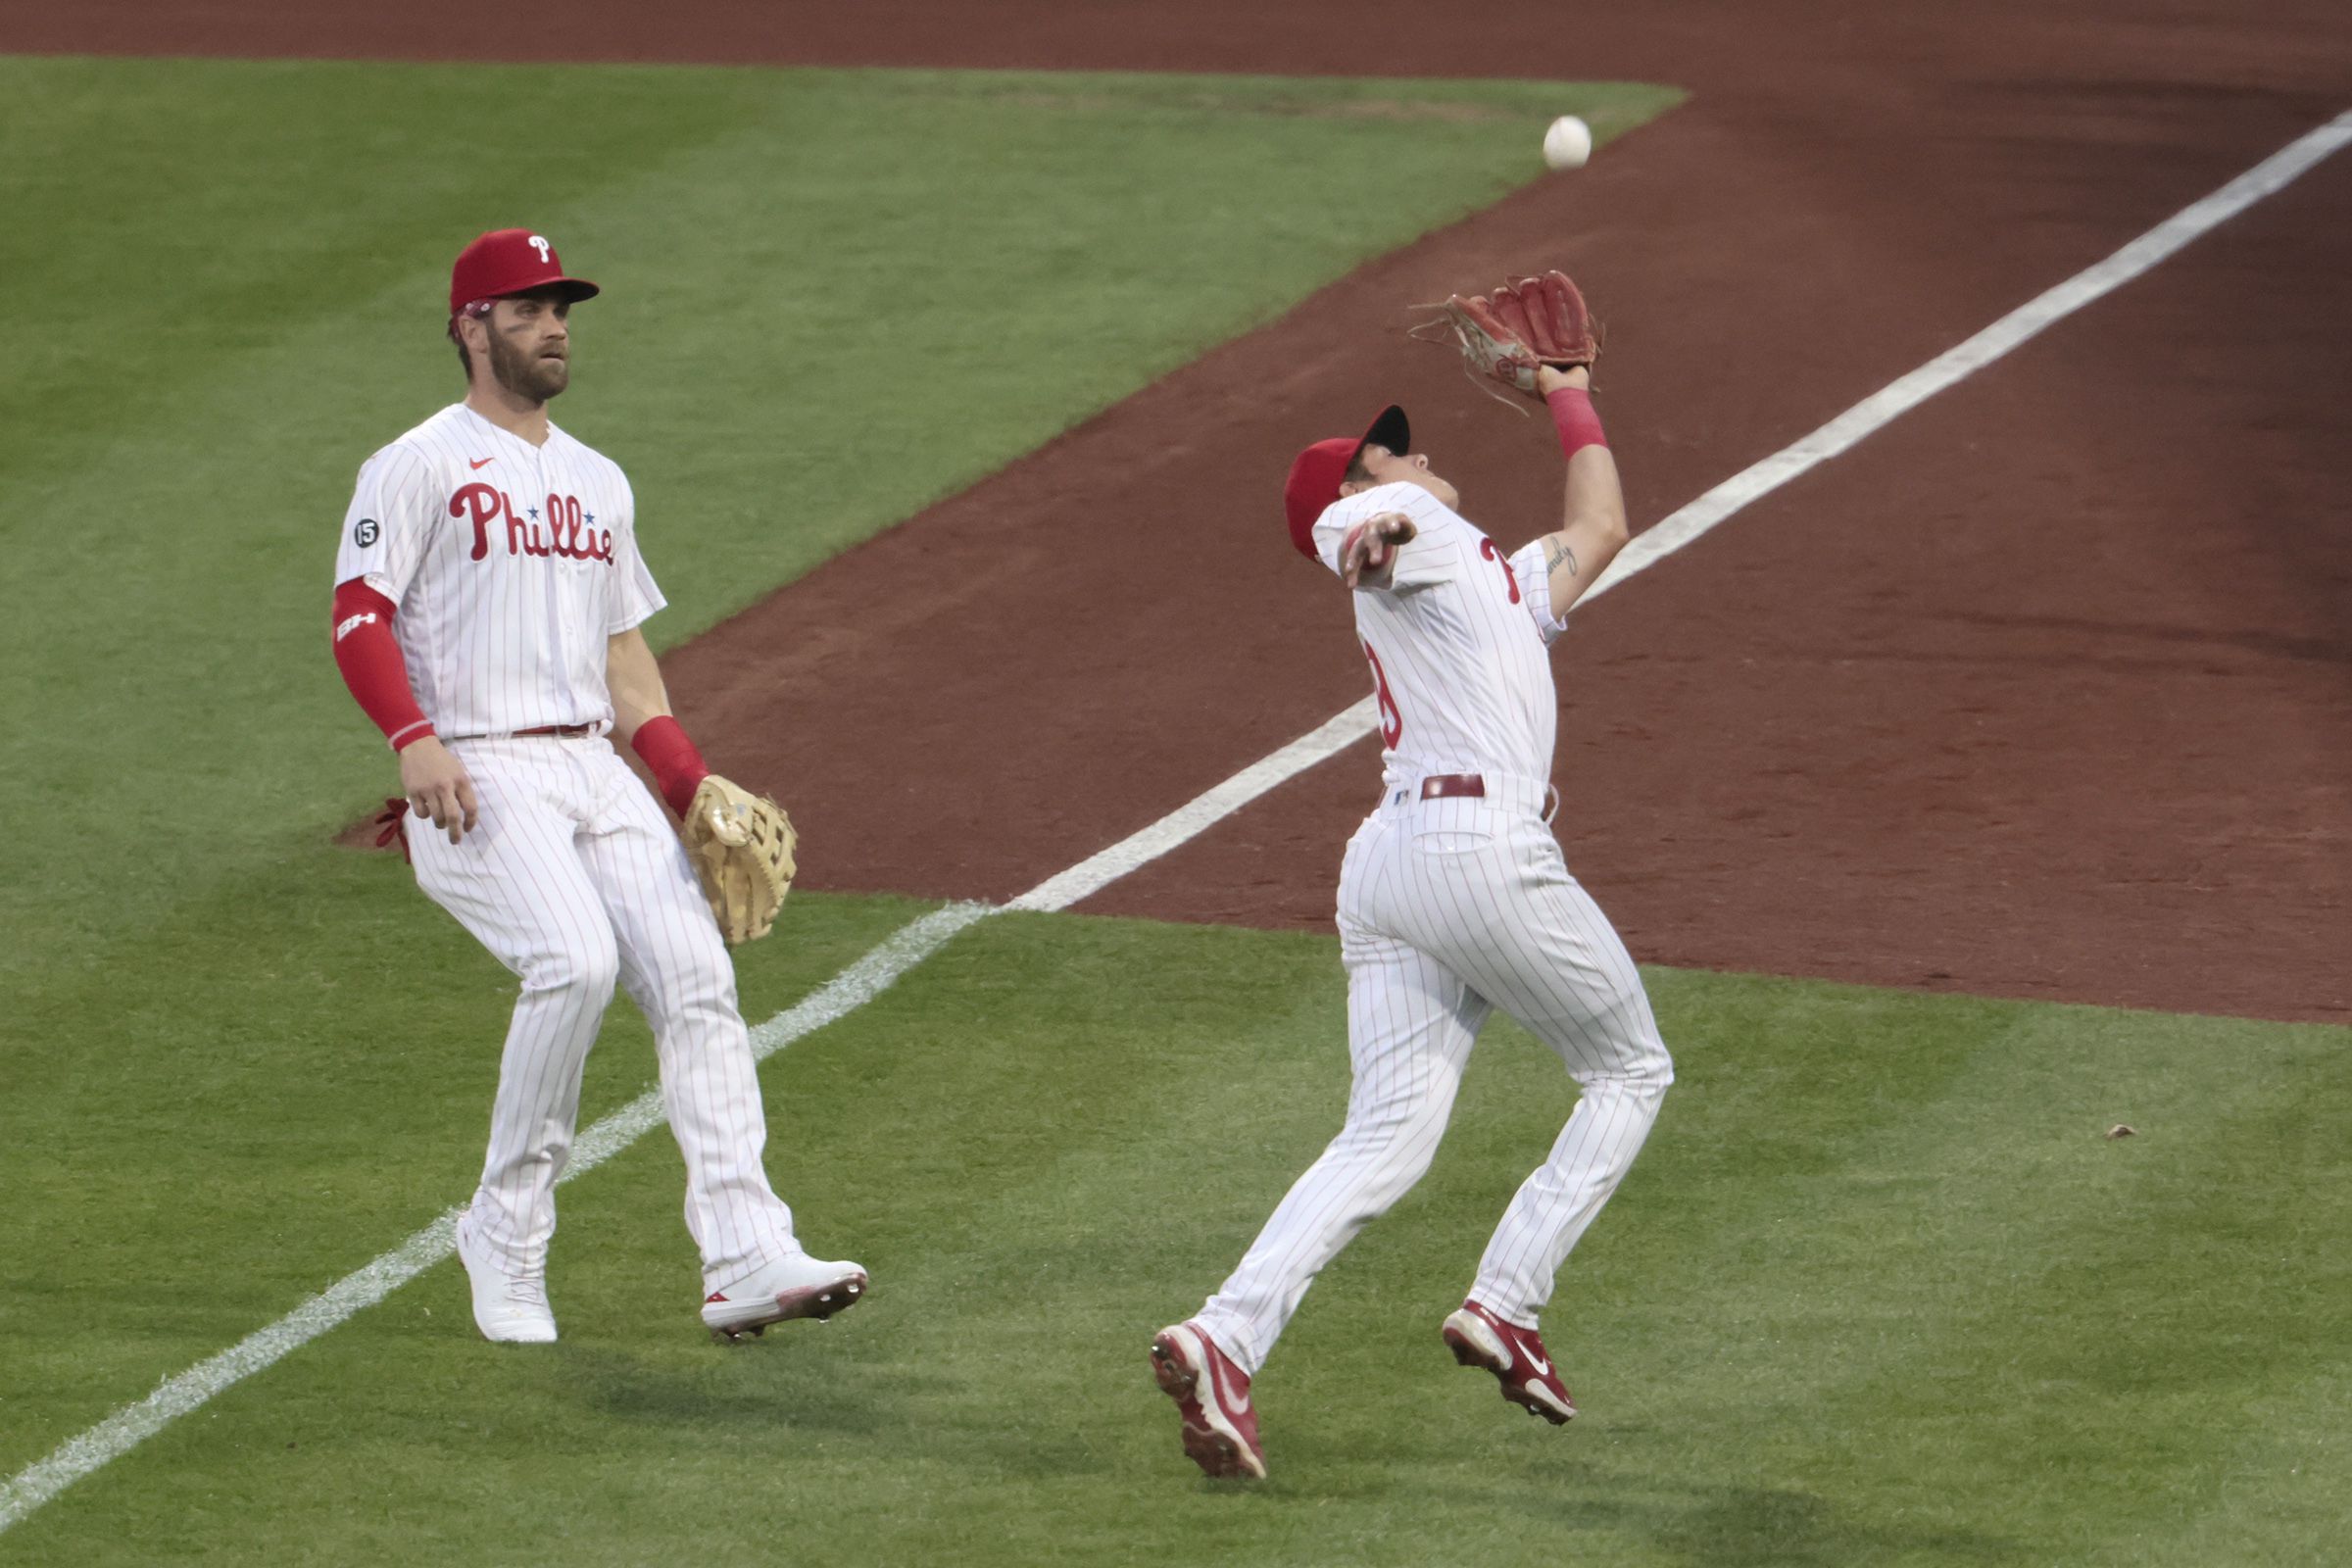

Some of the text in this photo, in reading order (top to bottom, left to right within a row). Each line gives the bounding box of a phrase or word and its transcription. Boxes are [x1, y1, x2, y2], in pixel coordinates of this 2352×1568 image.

[527, 235, 550, 264] P
[357, 521, 376, 545] 15
[449, 482, 613, 566] Phillie
